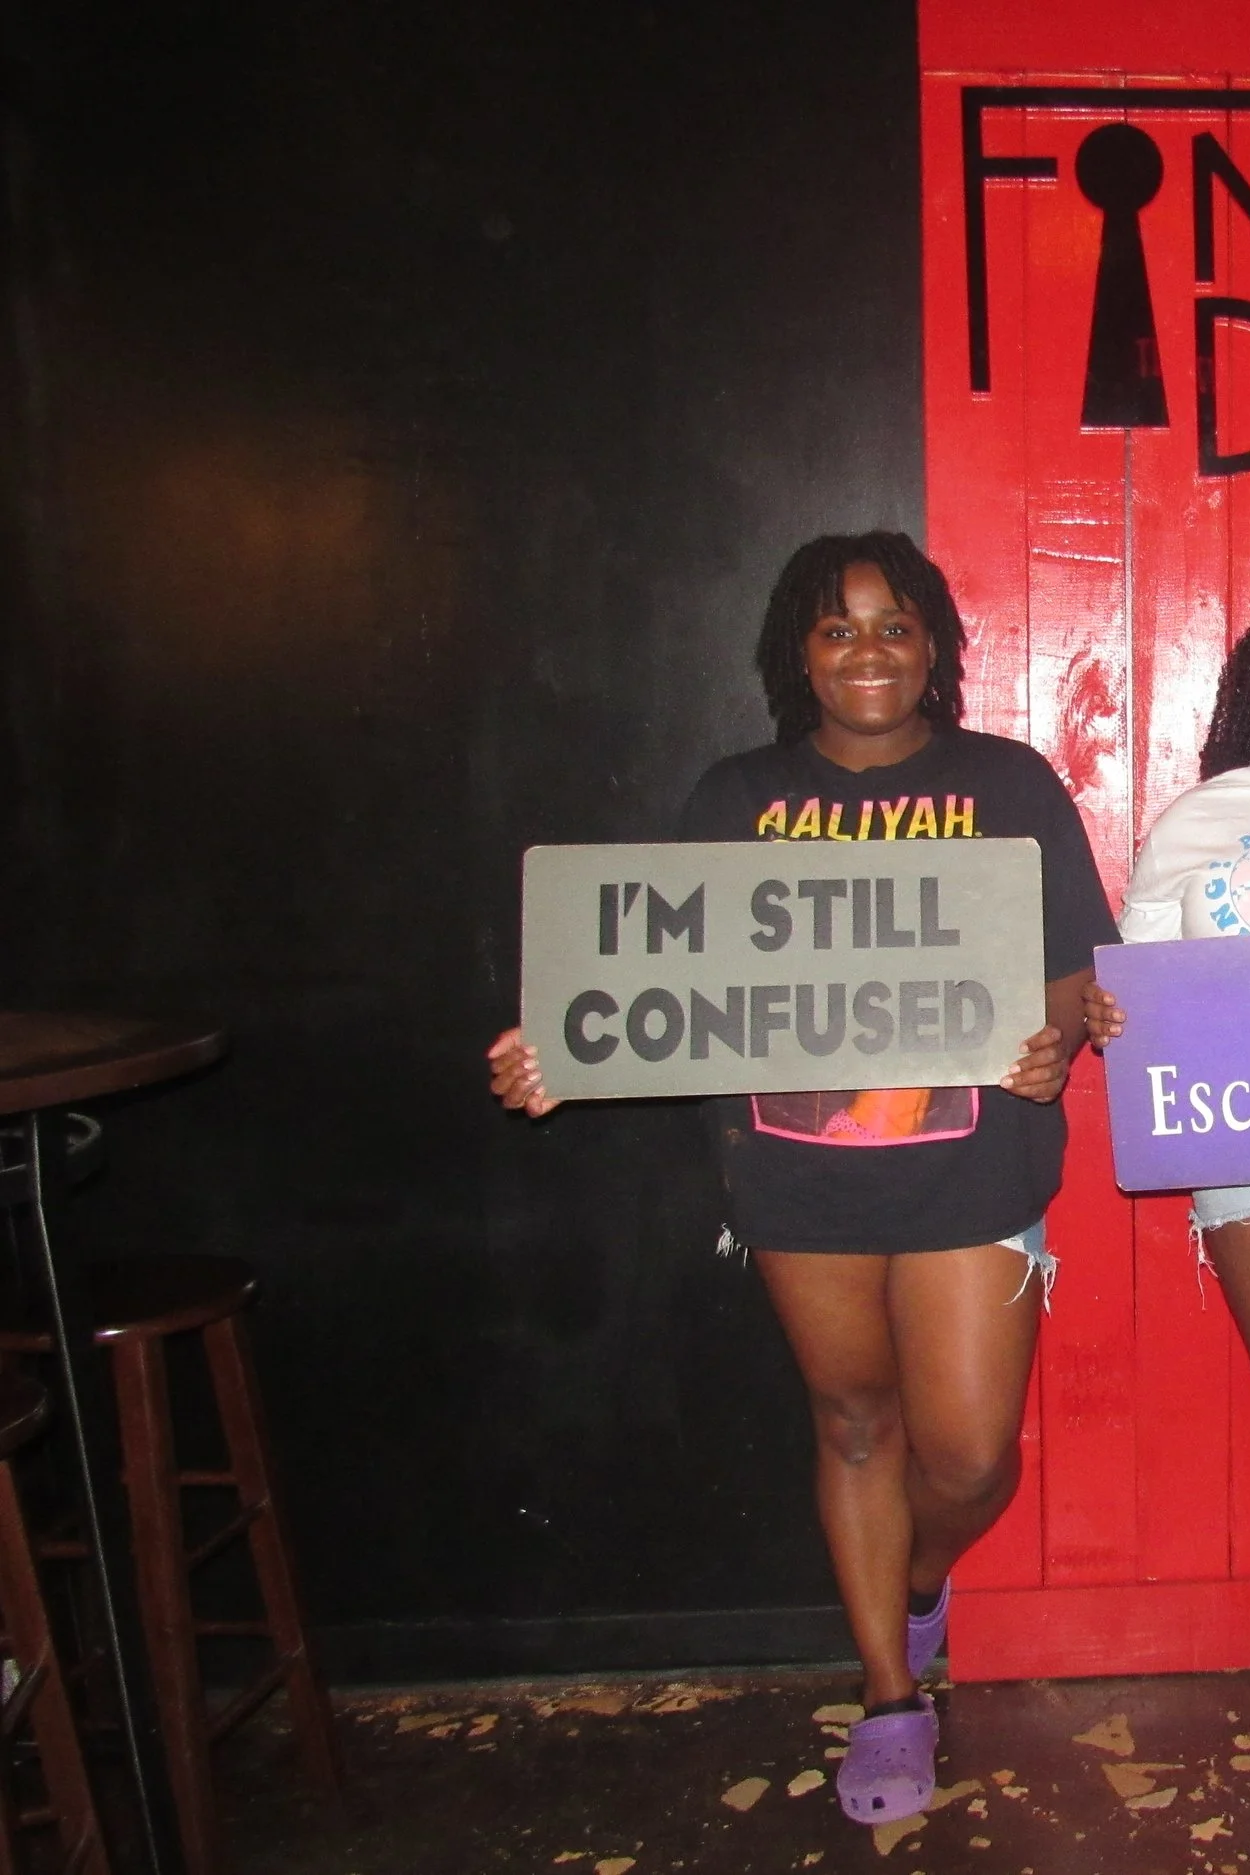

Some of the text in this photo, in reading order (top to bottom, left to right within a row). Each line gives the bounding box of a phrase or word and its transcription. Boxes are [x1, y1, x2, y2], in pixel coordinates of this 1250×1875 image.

[599, 877, 960, 956] I'M STILL
[564, 979, 994, 1064] CONFUSED
